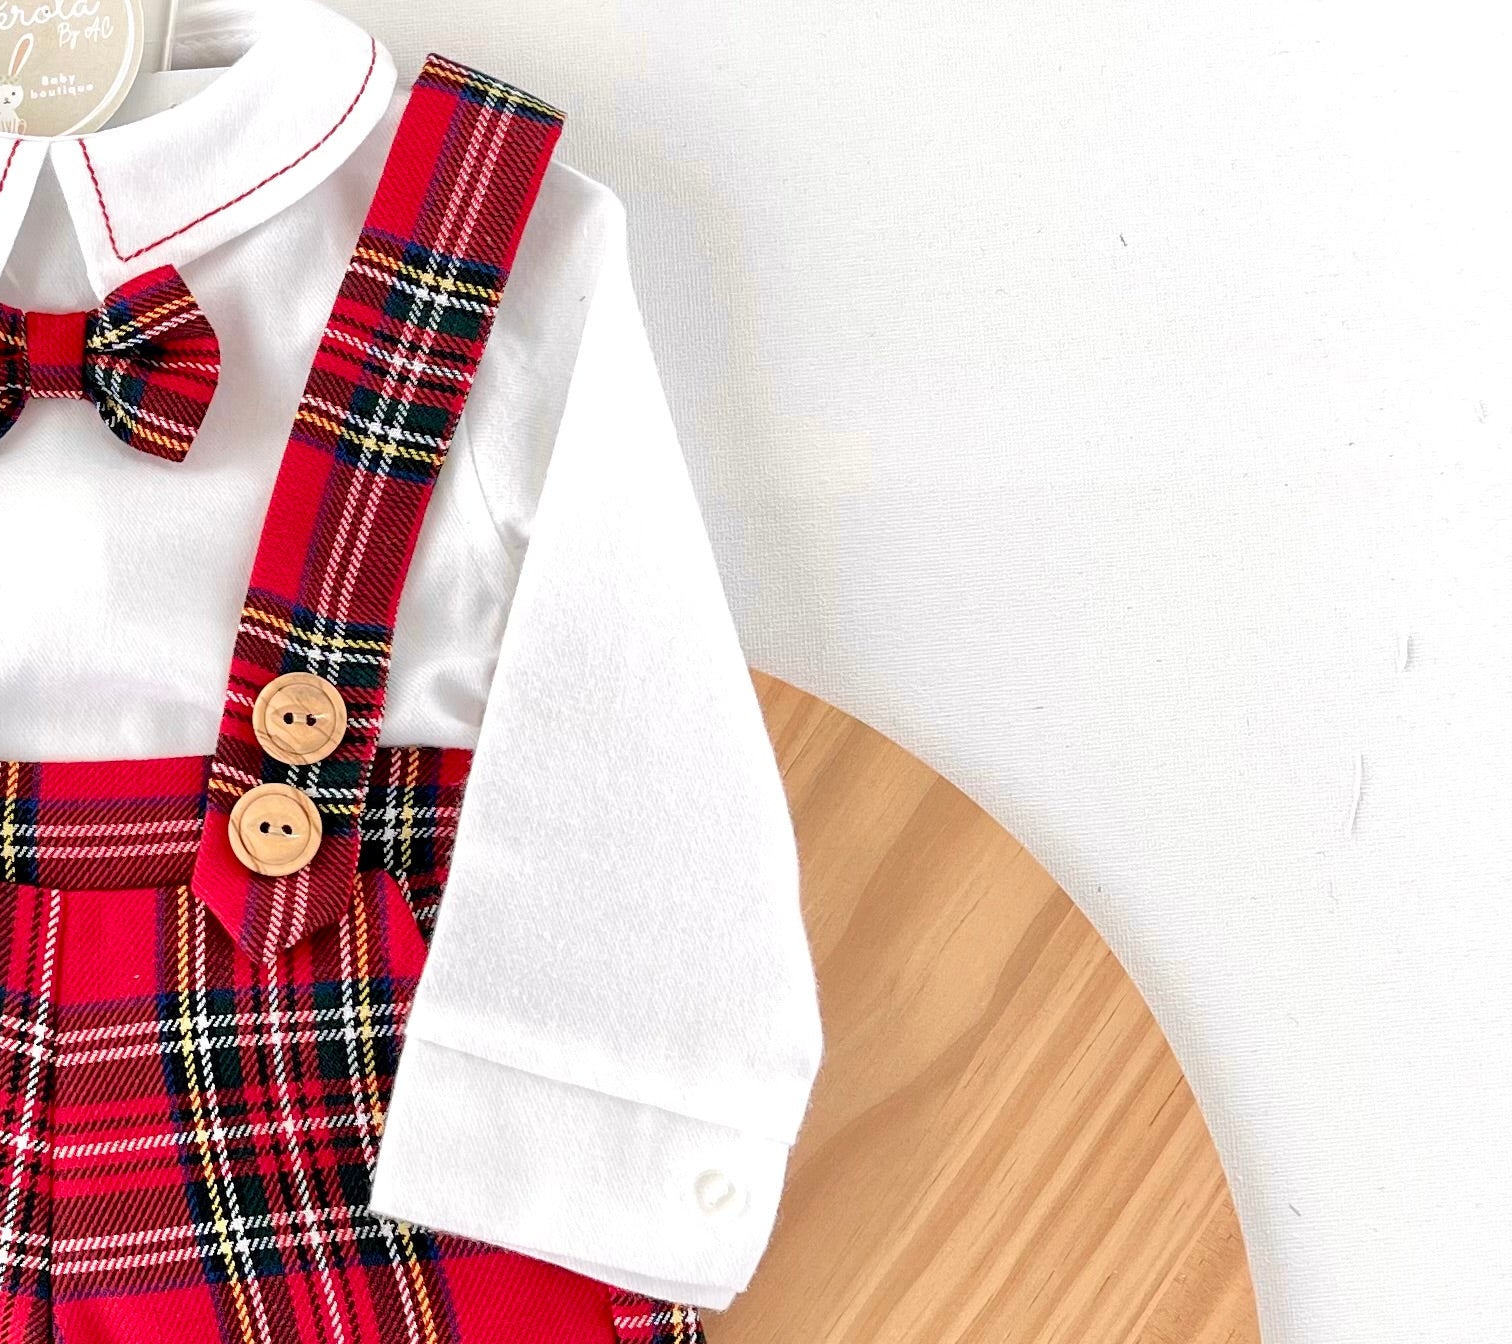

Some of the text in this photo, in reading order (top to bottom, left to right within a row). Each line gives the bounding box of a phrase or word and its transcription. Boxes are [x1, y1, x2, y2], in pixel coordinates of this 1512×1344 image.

[84, 16, 114, 42] AC
[41, 73, 76, 86] Baby
[30, 83, 94, 99] boutique
